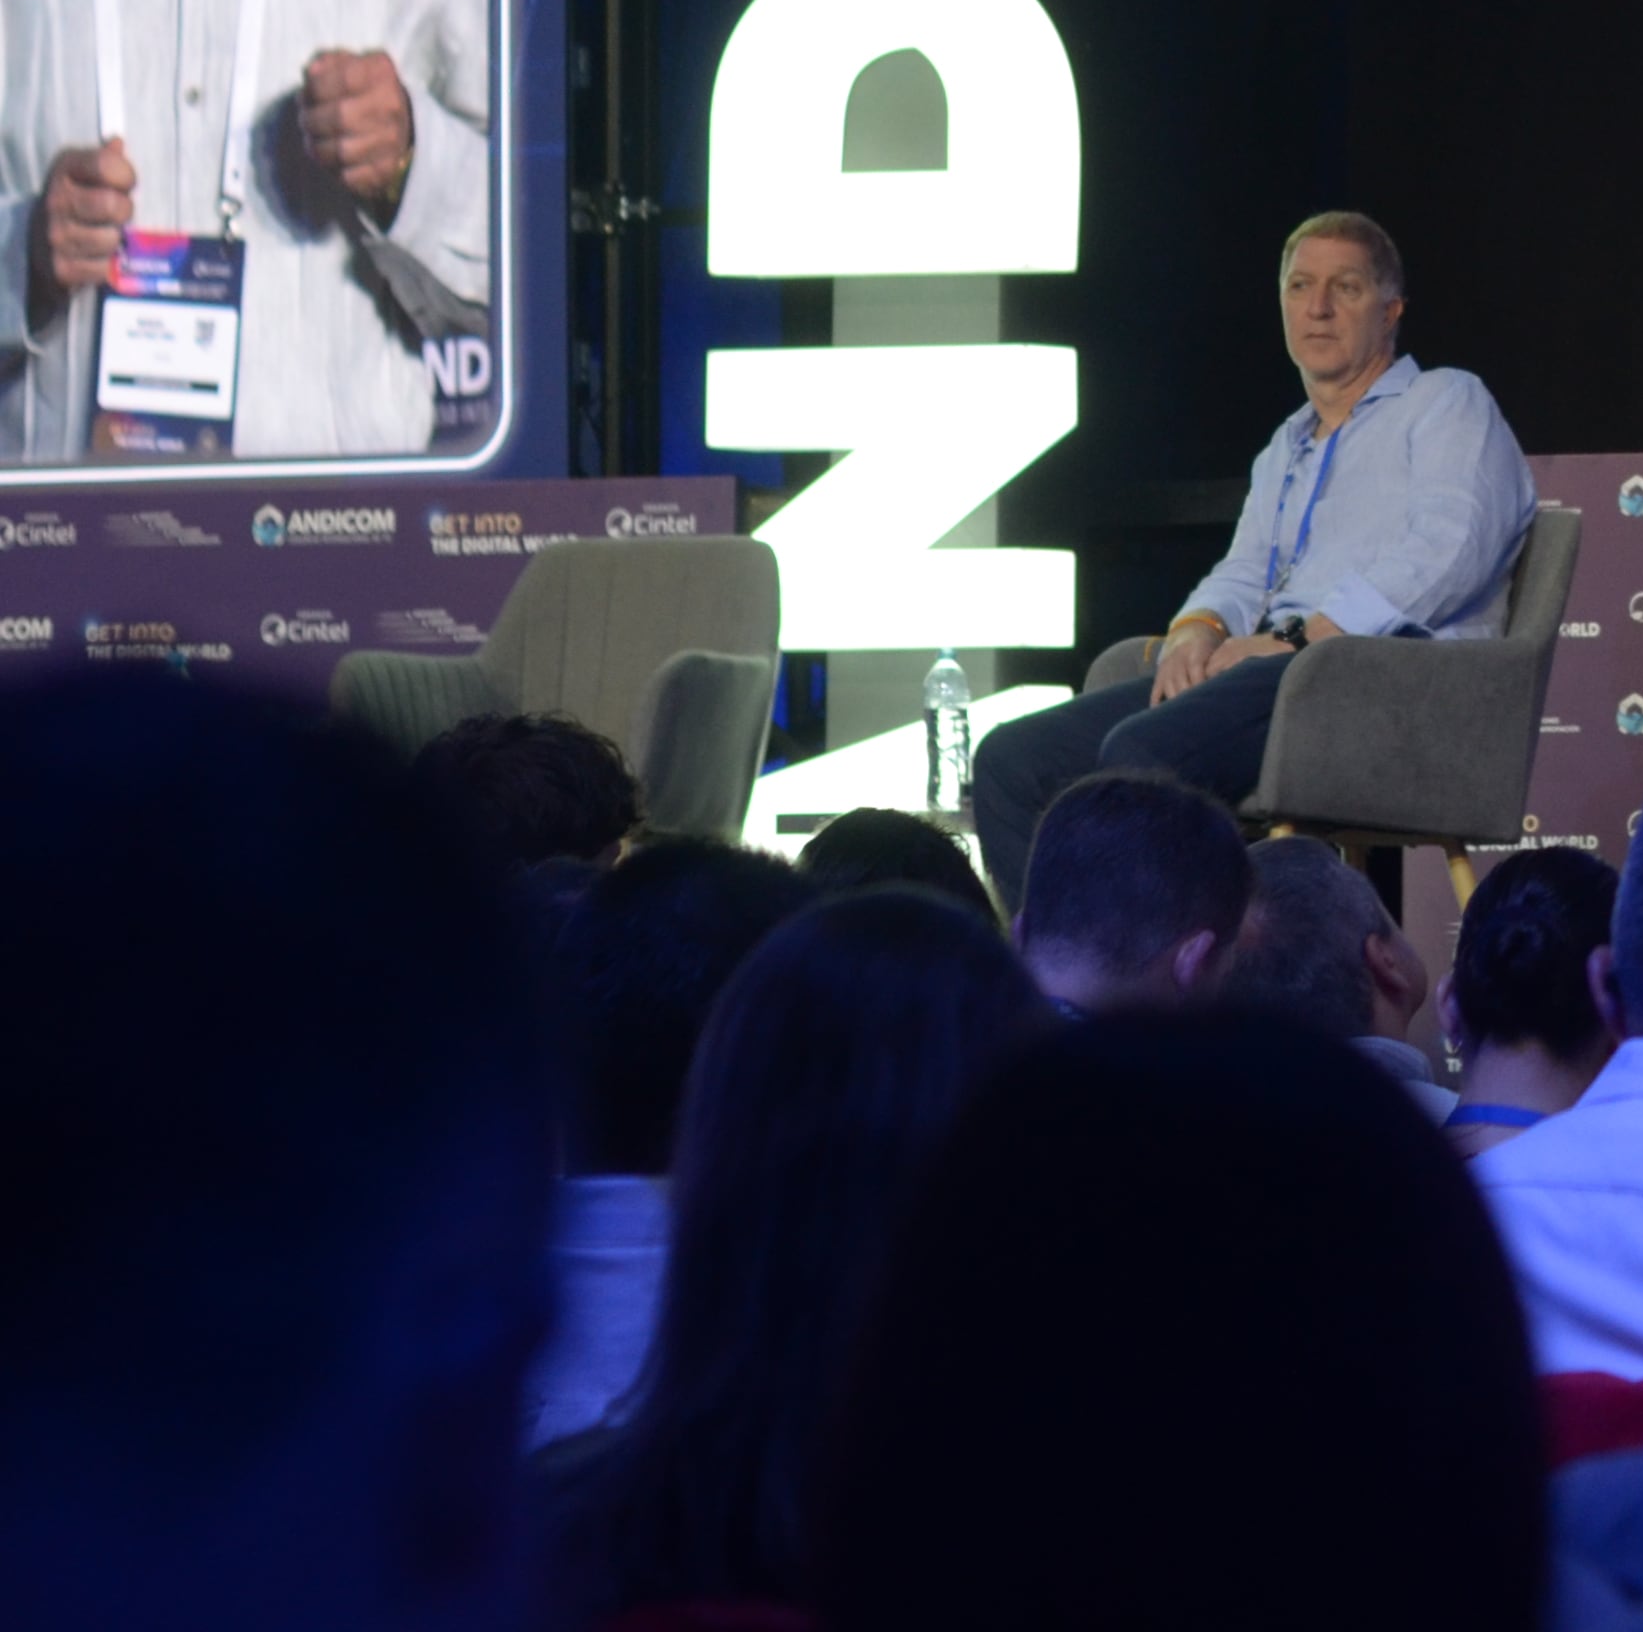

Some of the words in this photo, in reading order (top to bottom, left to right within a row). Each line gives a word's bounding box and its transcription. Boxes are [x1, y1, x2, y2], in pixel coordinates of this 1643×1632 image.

[287, 507, 397, 535] ANDICOM
[634, 513, 697, 535] Cintel
[288, 620, 350, 643] Cintel
